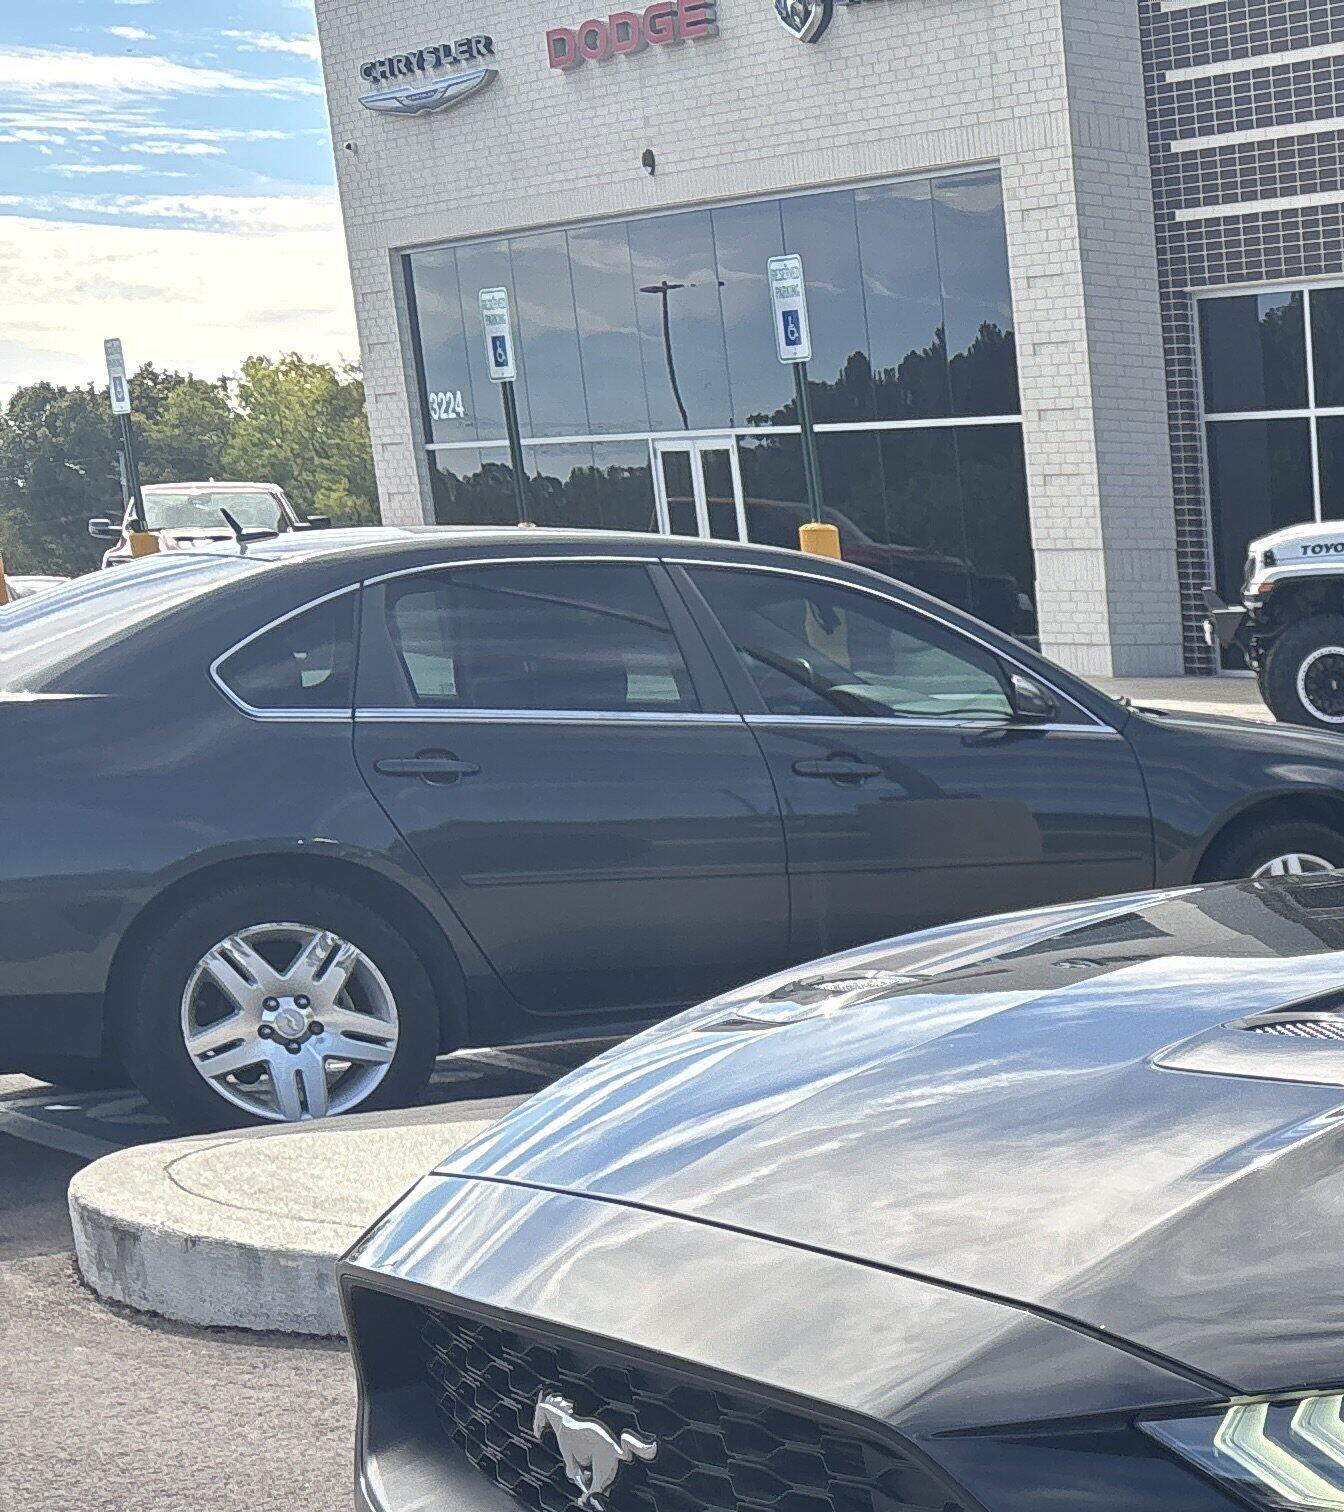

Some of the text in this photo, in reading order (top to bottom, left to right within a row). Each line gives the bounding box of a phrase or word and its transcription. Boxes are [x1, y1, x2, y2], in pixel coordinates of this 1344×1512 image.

[360, 35, 494, 81] CHRYSLER
[546, 0, 717, 70] DODGE
[429, 390, 465, 420] 3224
